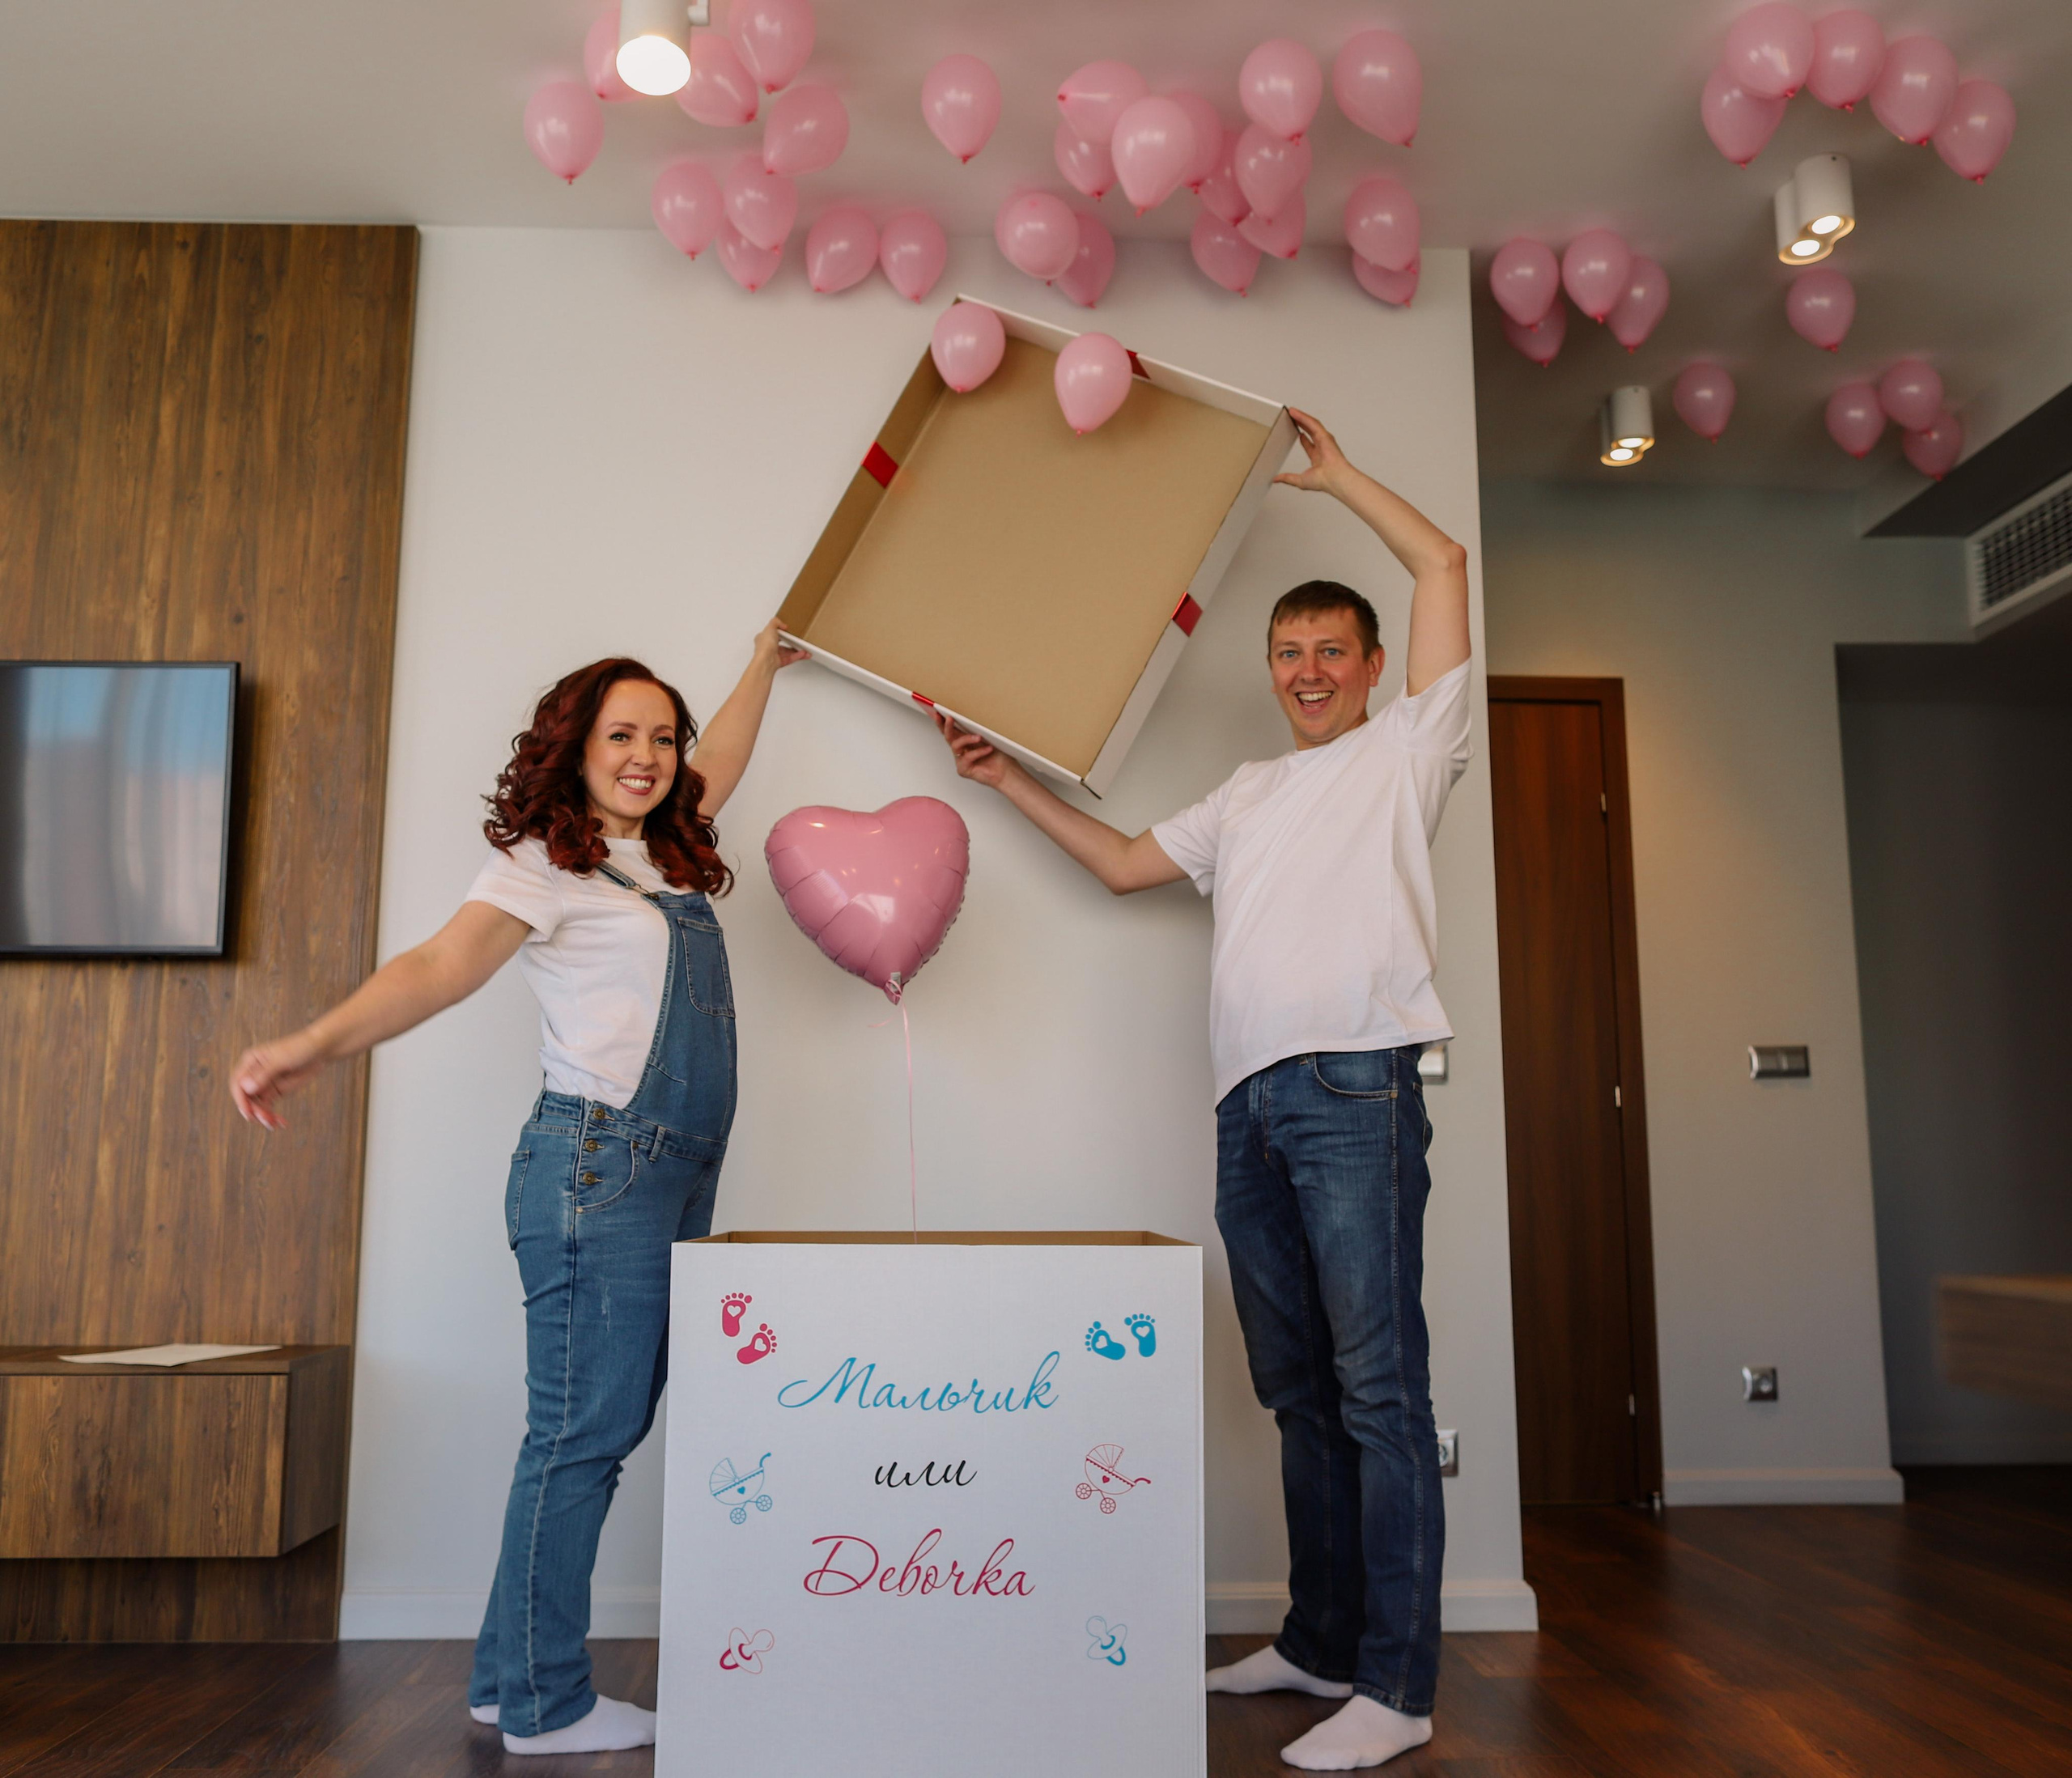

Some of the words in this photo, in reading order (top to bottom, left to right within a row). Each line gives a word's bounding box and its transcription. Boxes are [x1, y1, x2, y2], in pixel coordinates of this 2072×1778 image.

[777, 1350, 1060, 1414] Мальчик
[874, 1459, 978, 1488] или
[804, 1528, 1035, 1597] Девочка
